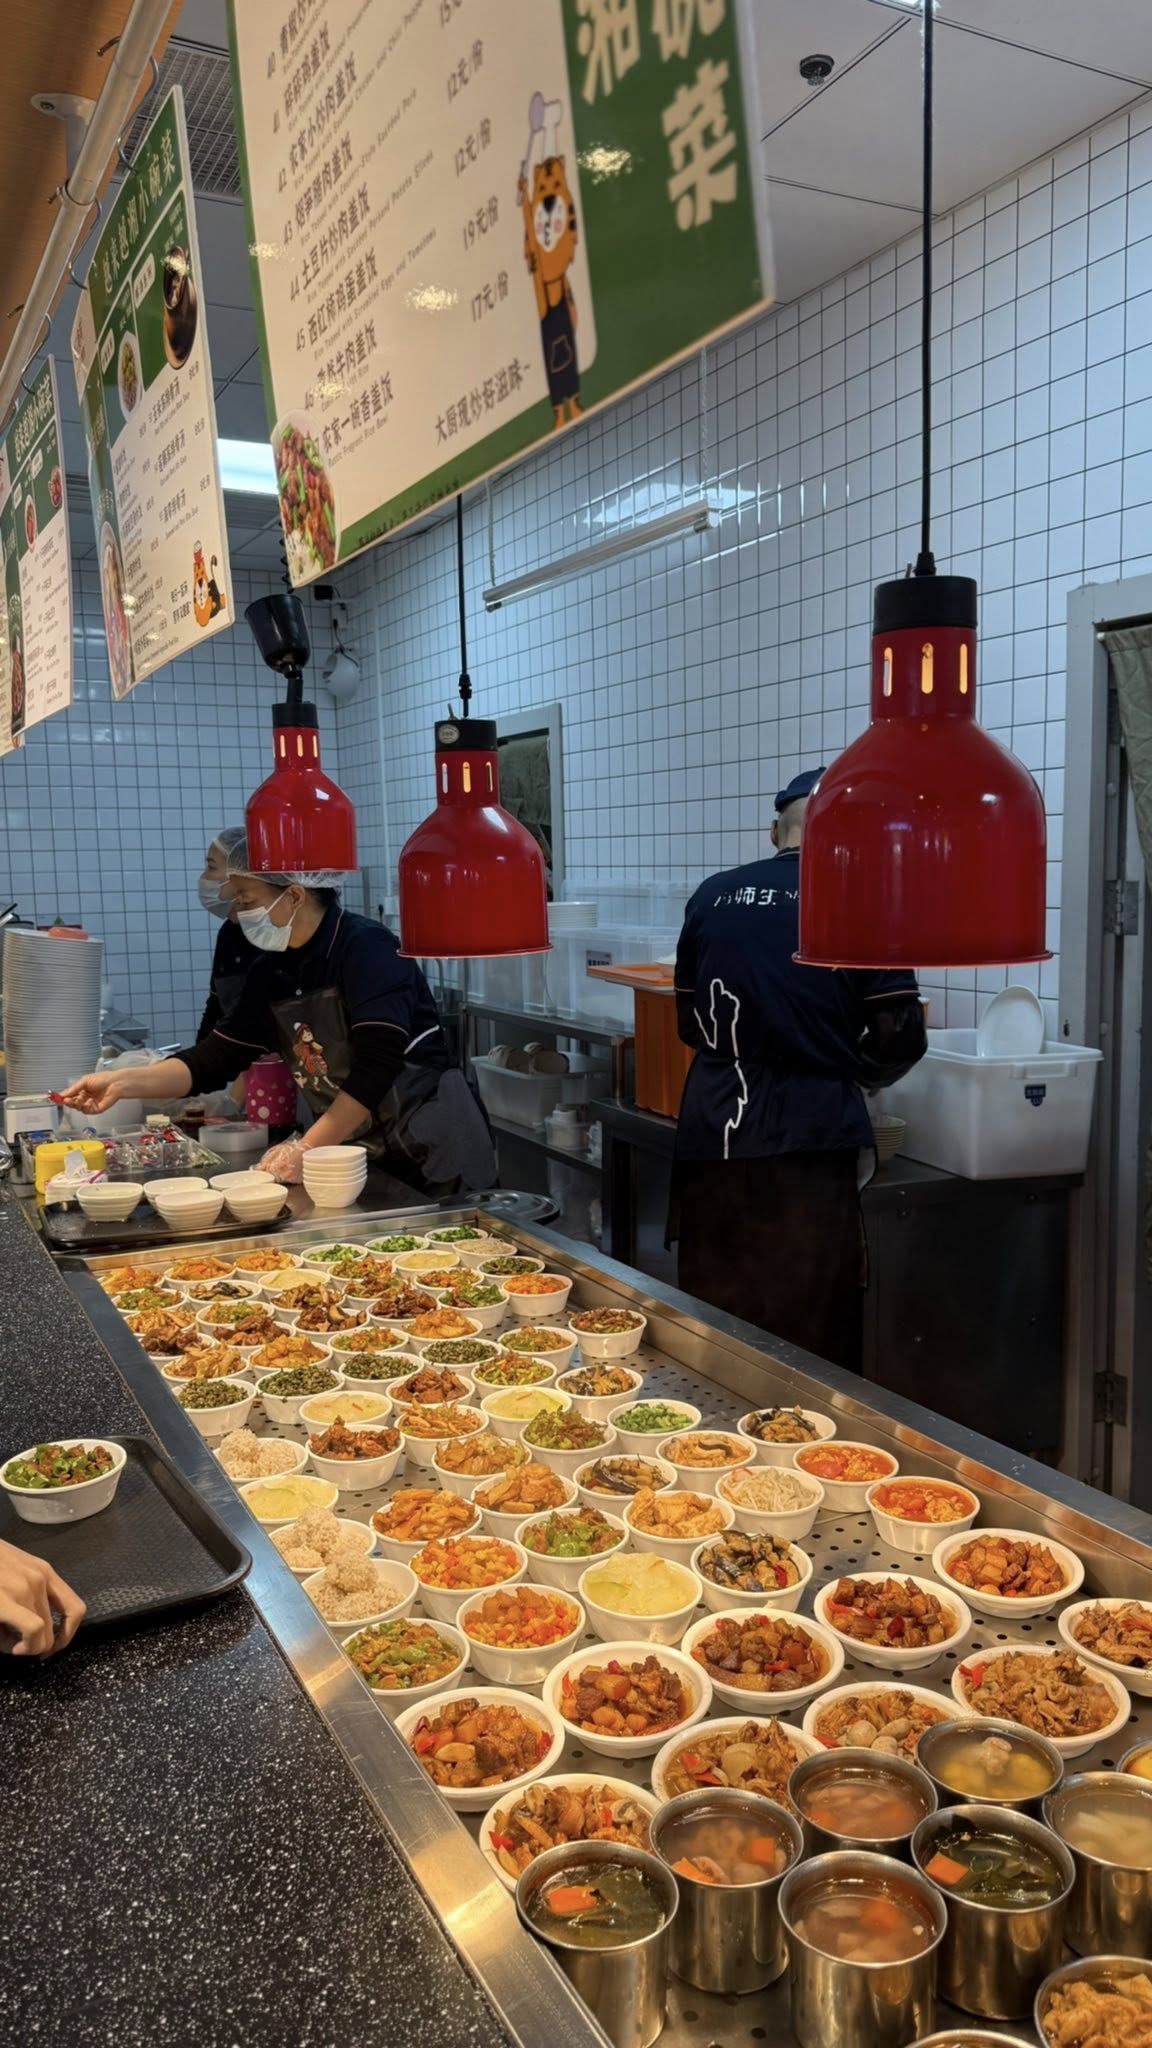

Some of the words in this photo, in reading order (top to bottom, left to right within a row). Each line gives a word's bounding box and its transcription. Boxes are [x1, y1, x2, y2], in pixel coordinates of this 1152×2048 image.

[302, 182, 370, 290] 土豆片炒肉盖饭
[307, 246, 377, 346] 西红柿鸡蛋盖饭
[321, 371, 394, 452] 农家一碗香盖饭
